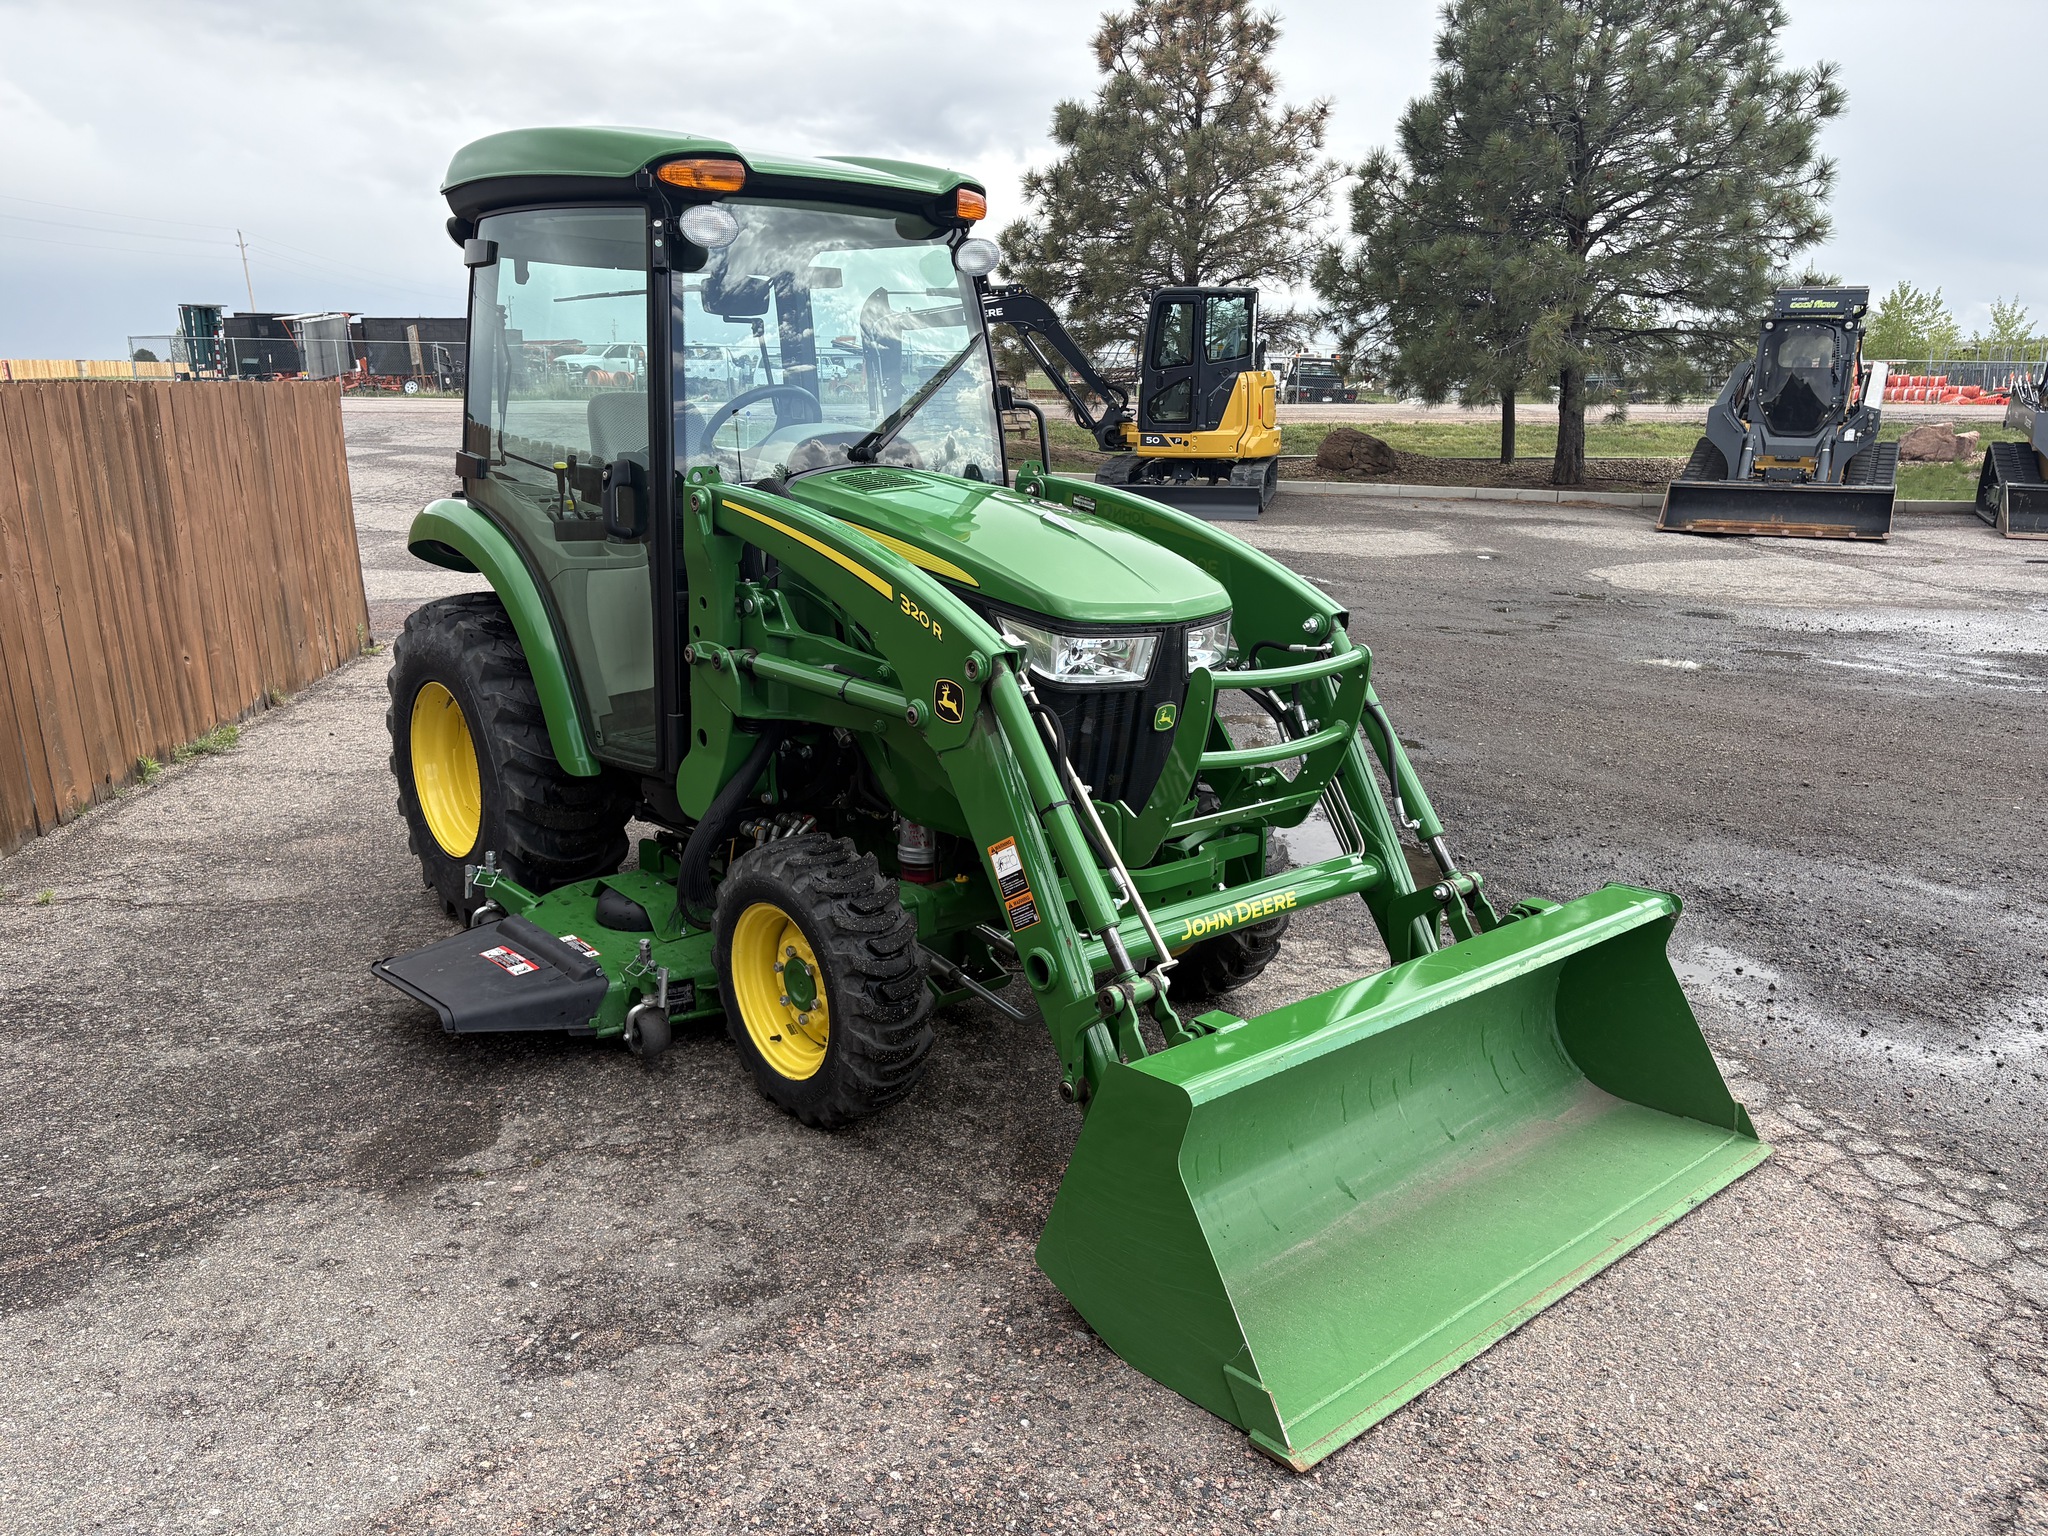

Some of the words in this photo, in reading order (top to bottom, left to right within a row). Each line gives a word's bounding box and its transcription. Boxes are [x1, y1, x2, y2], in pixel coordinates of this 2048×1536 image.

[1145, 436, 1160, 444] 50
[900, 592, 930, 629] 320
[932, 620, 943, 642] R
[1181, 909, 1233, 941] JOHN
[1234, 890, 1297, 923] DEERE
